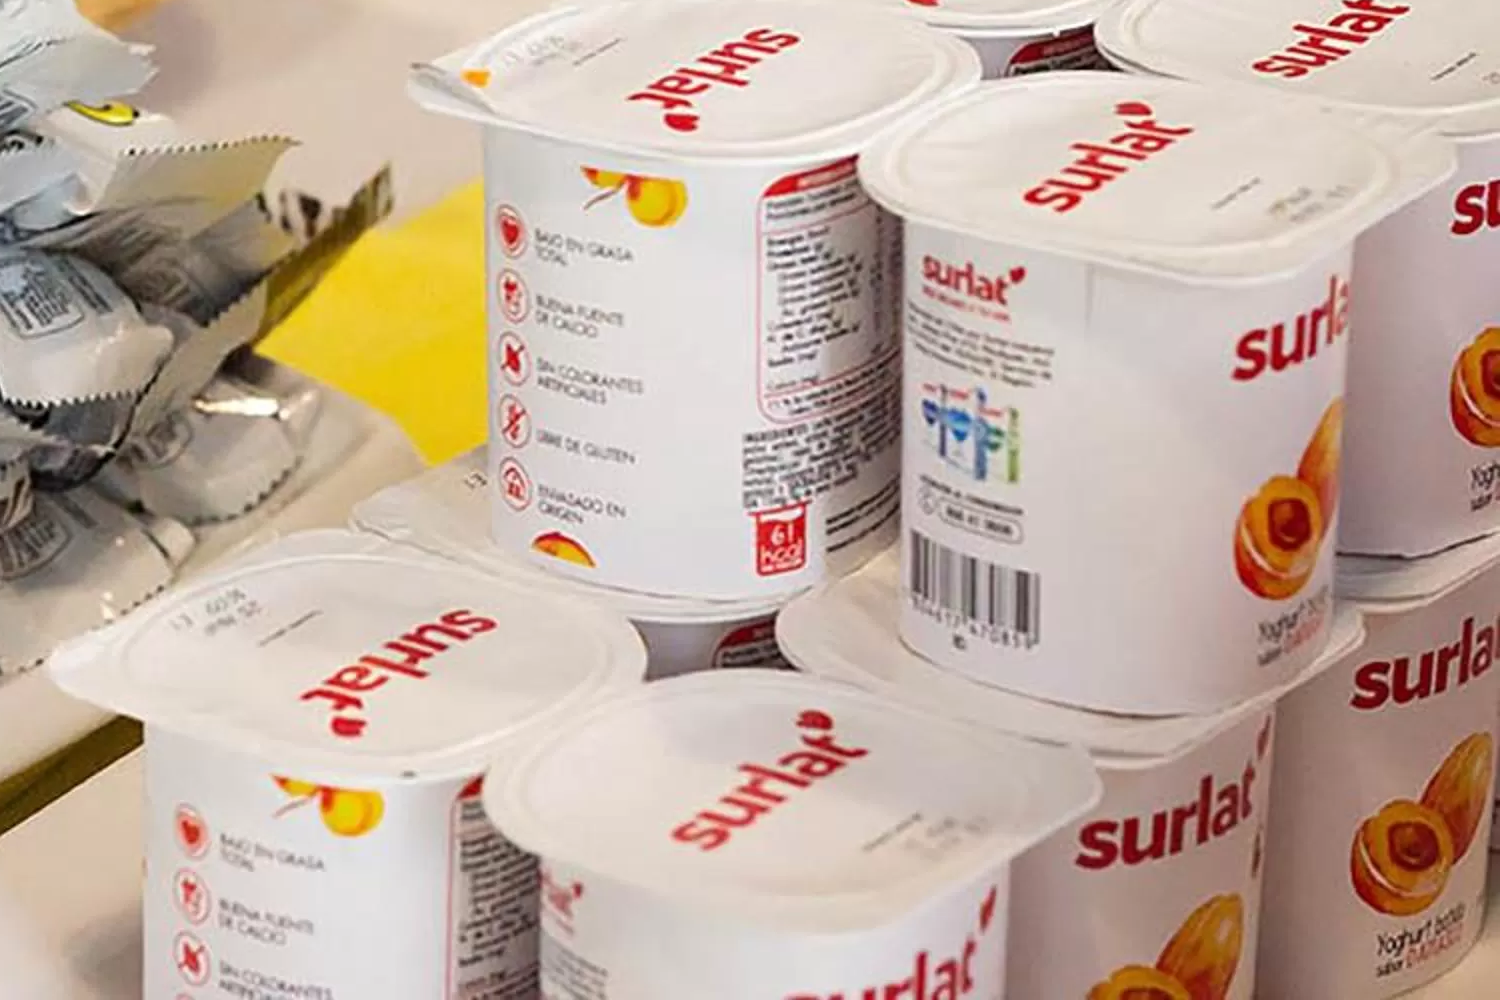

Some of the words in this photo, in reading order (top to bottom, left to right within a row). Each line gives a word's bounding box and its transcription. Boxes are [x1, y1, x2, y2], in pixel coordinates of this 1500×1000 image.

[627, 28, 800, 120] surlat
[1022, 112, 1194, 214] surlat
[922, 255, 1008, 306] surlat
[771, 524, 796, 546] 61
[301, 608, 500, 714] surlat
[672, 722, 869, 852] surlat
[1074, 765, 1257, 872] surlat
